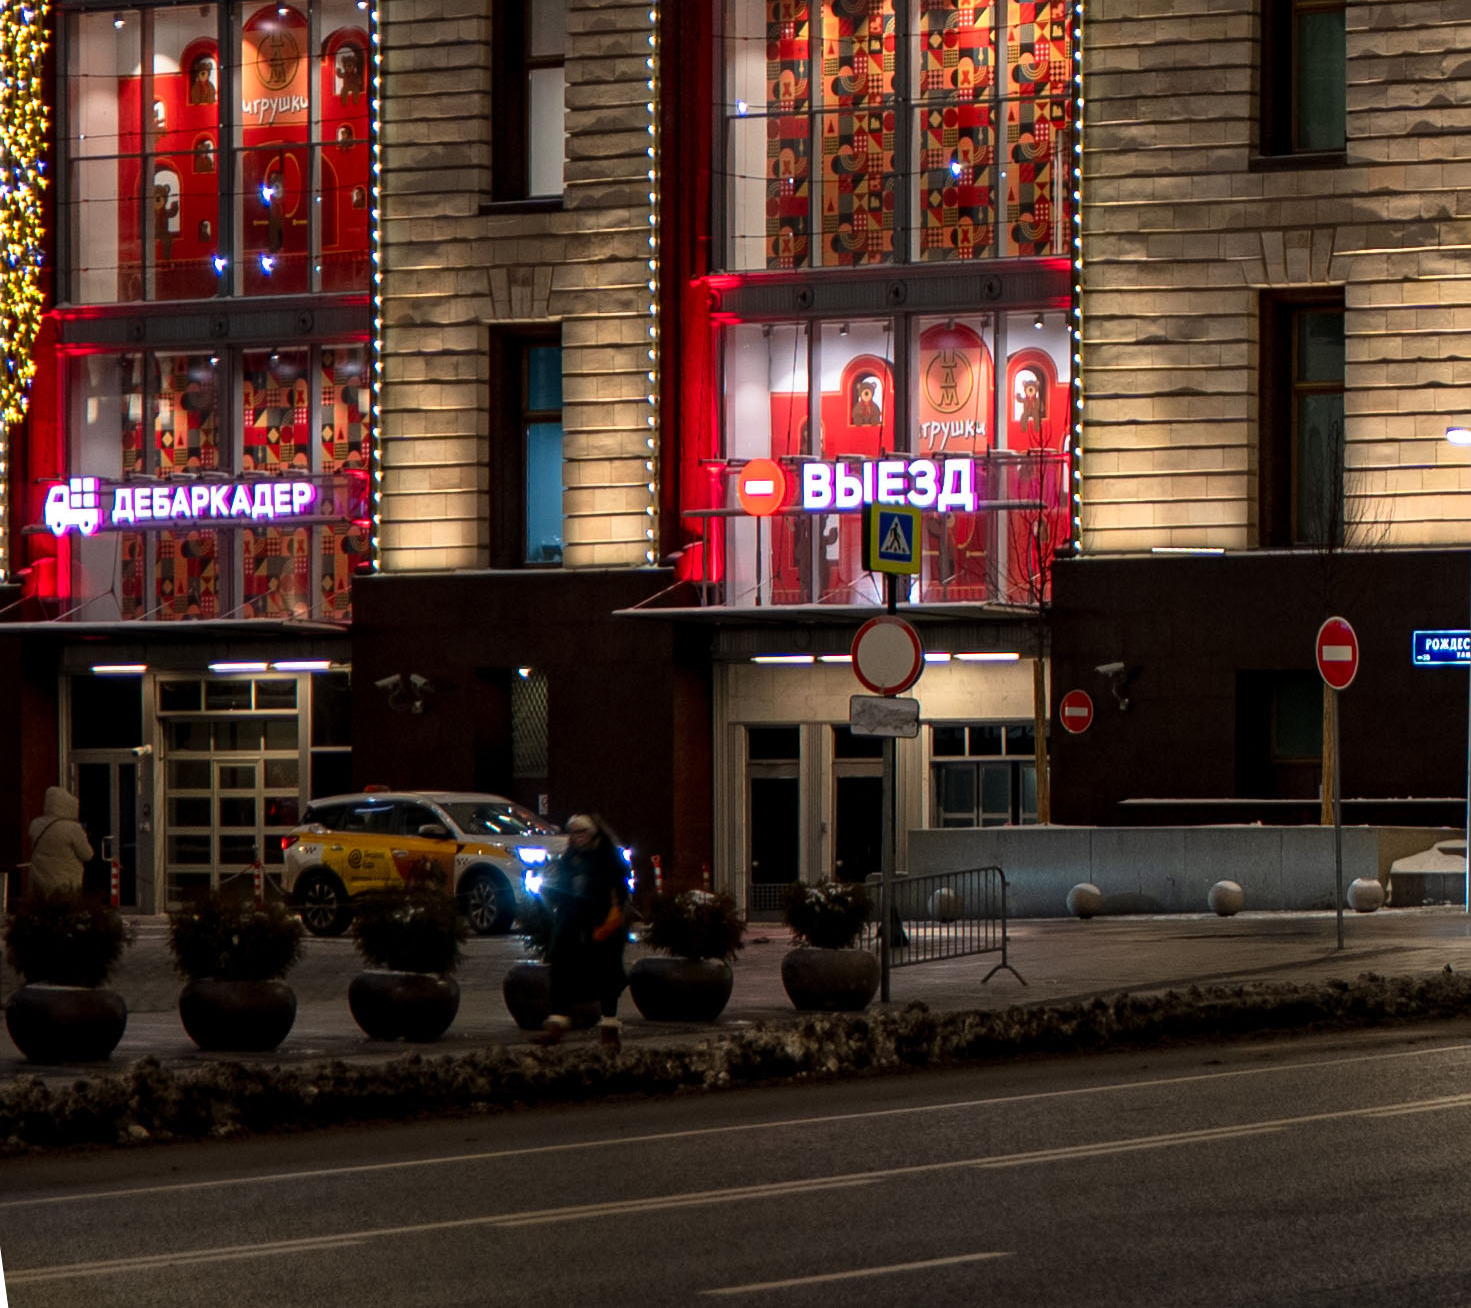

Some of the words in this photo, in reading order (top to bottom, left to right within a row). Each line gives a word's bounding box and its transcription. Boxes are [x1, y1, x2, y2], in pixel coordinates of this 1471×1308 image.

[242, 95, 309, 126] игрушки
[920, 418, 986, 451] грушки
[112, 482, 315, 524] ДЕБАРКАДЕР
[803, 459, 977, 512] ВЫЕЗД
